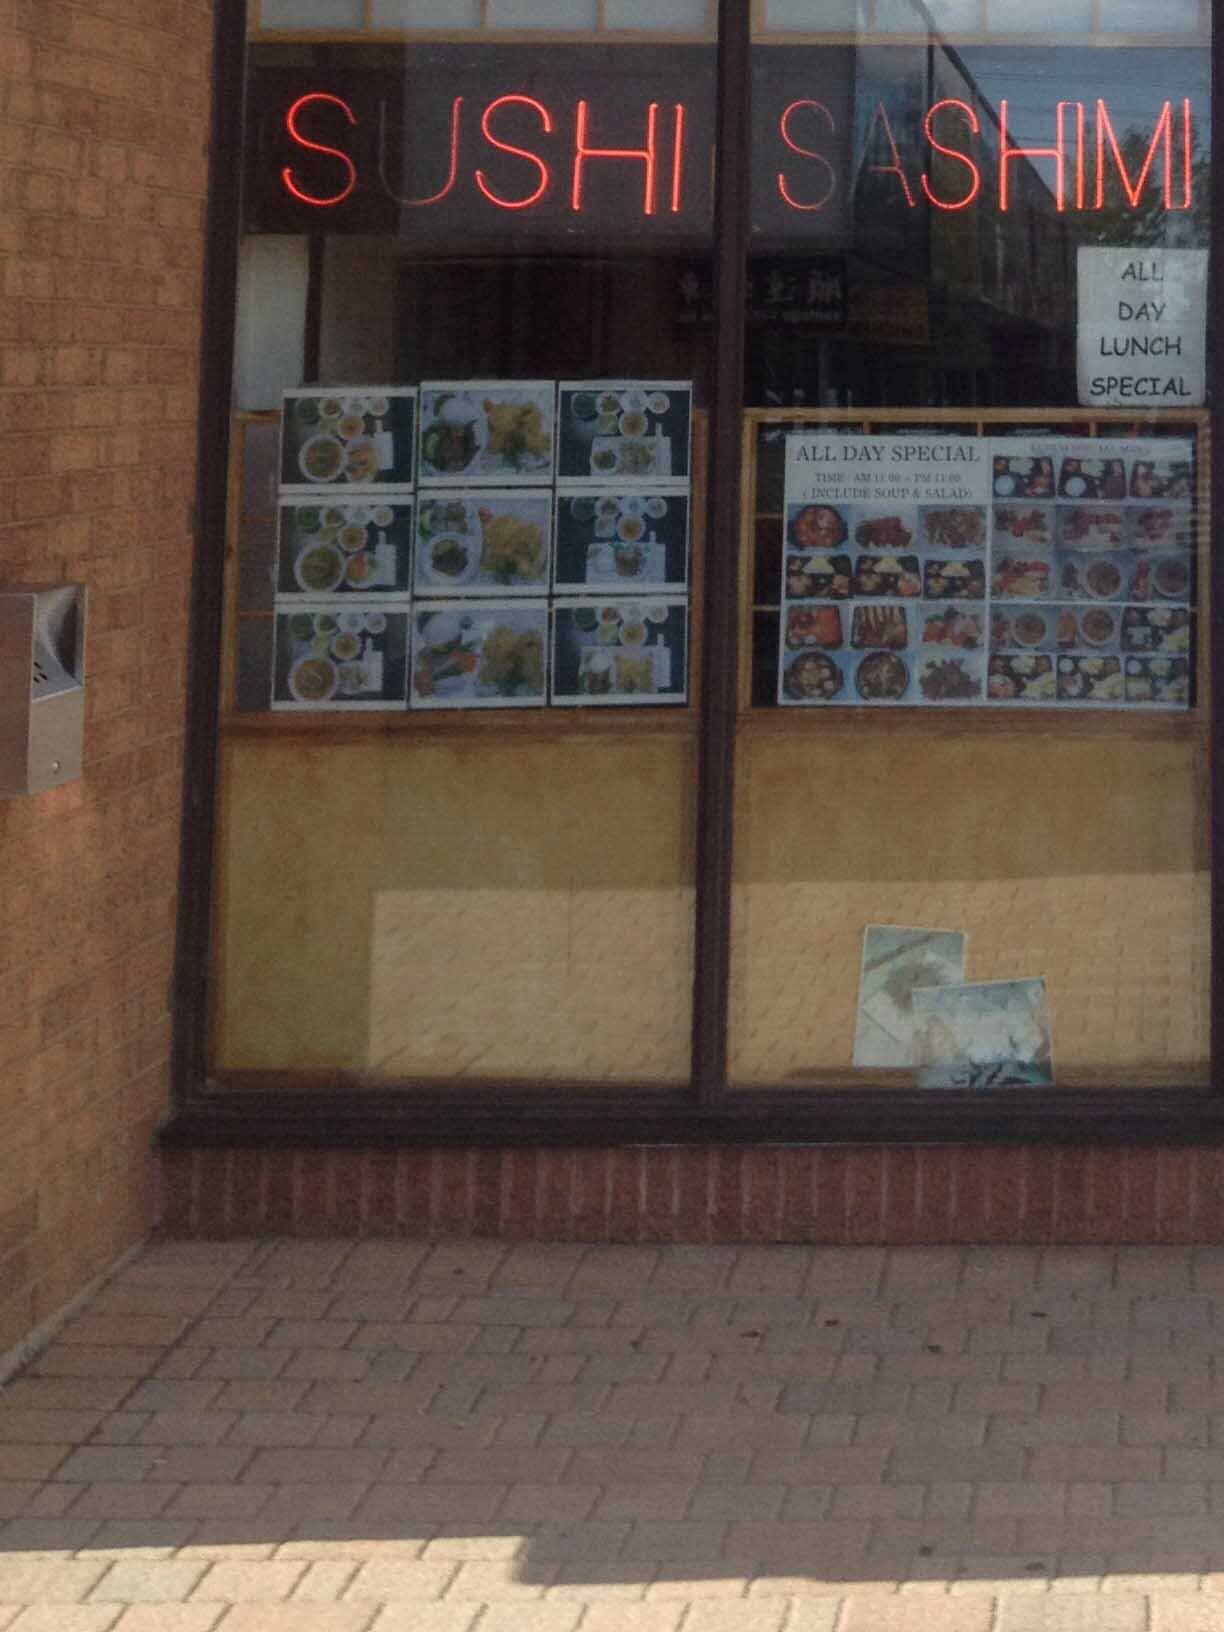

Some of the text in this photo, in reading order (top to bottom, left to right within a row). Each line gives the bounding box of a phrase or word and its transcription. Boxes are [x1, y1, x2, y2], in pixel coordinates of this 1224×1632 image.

[281, 92, 686, 216] SUSHI
[776, 97, 1194, 213] SASHIMI
[1121, 261, 1164, 281] ALL
[1118, 300, 1167, 321] DAY
[1100, 335, 1182, 357] LUNCH
[1089, 375, 1192, 397] SPECIAL
[796, 444, 981, 463] ALL DAY SPECIAL
